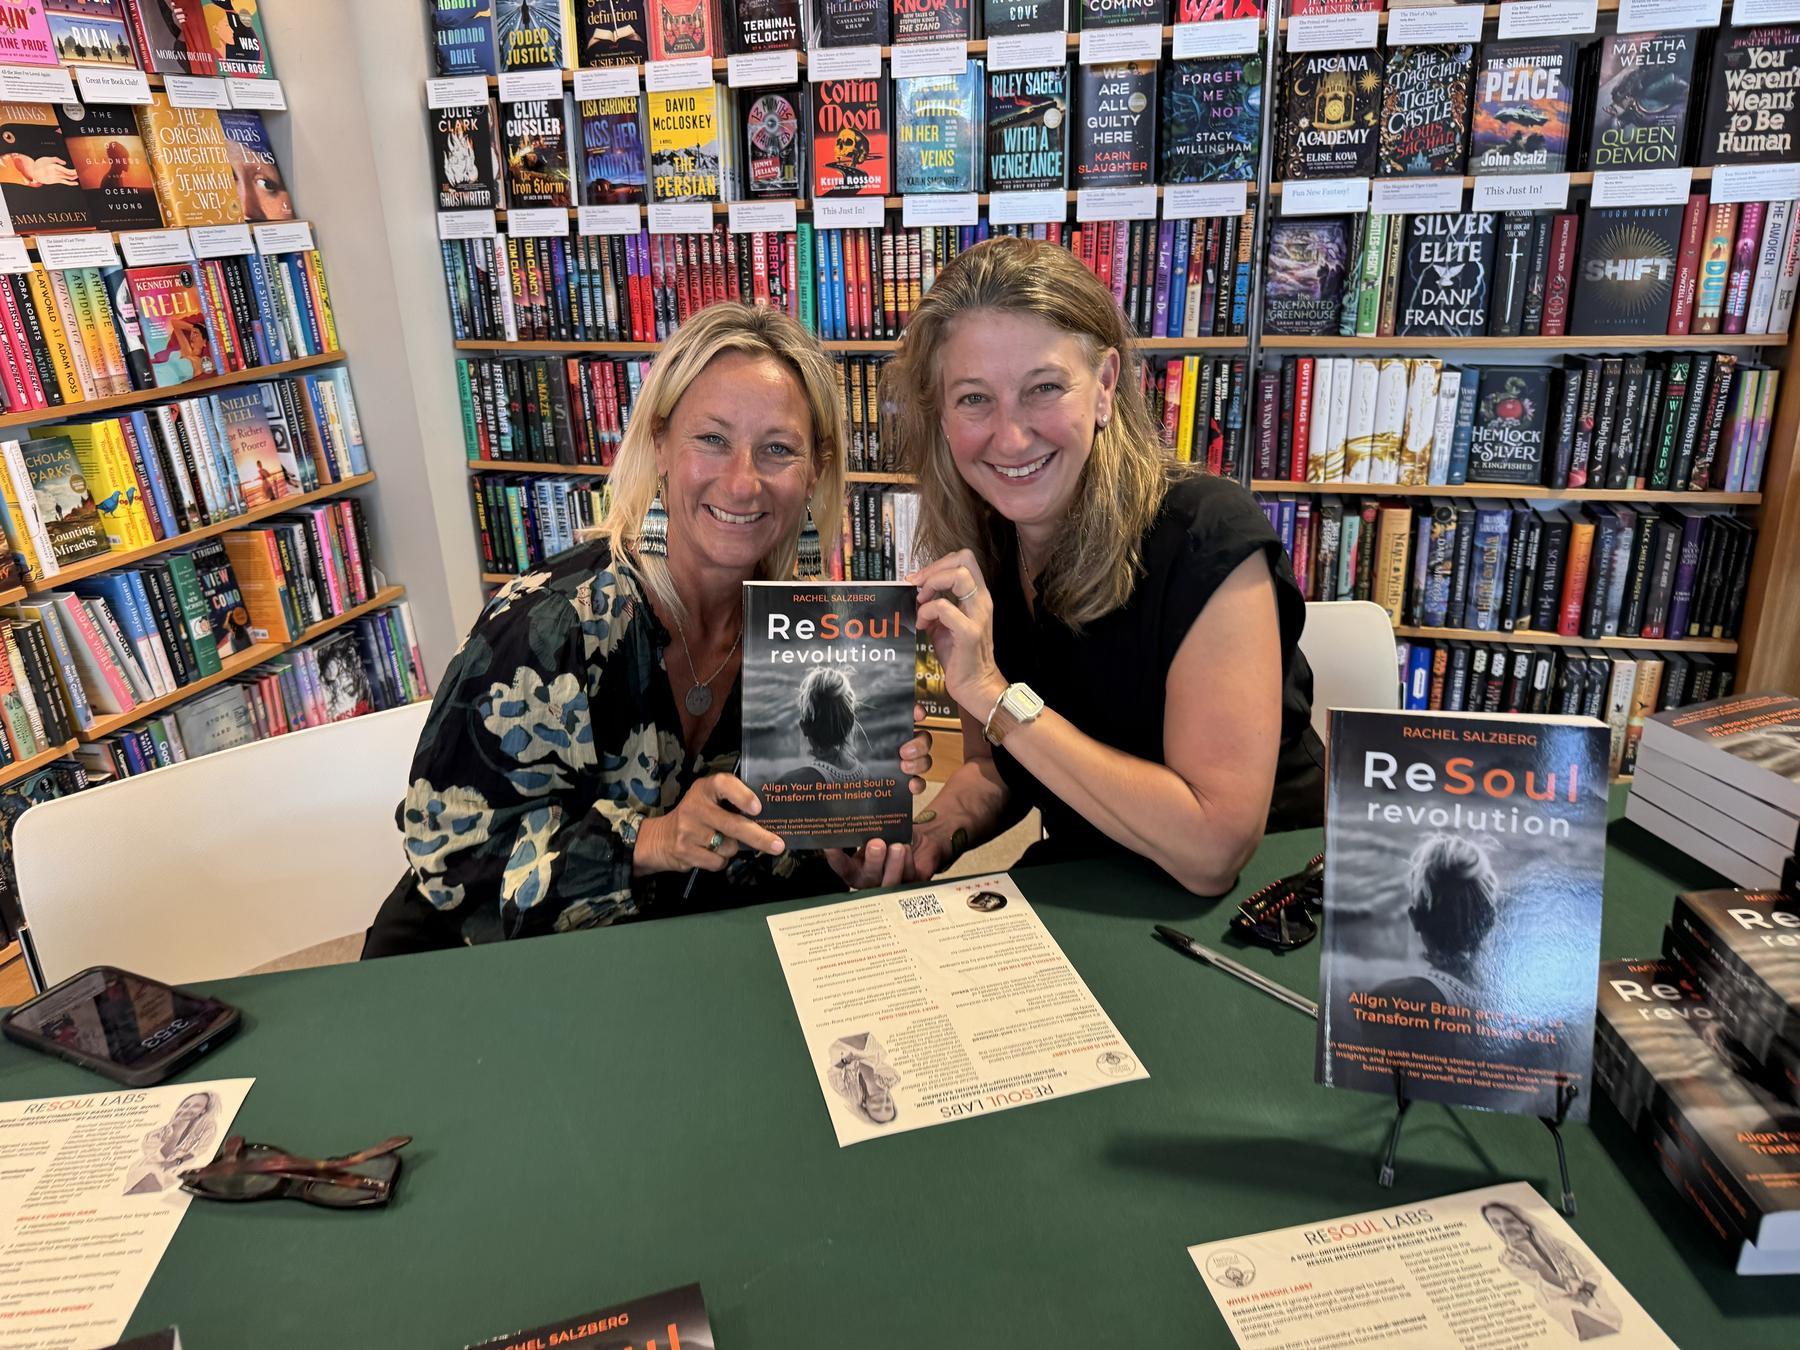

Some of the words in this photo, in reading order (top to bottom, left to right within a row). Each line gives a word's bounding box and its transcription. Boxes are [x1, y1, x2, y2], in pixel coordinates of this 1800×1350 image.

[1010, 5, 1038, 20] COVE
[743, 17, 795, 31] TERMINAL
[915, 23, 940, 32] STAND
[71, 27, 111, 48] RYAN
[239, 37, 259, 50] WAS
[744, 29, 796, 44] VELOCITY
[507, 47, 555, 65] JUSTICE
[1614, 39, 1686, 55] MARTHA
[450, 49, 476, 64] DRIVE
[1306, 56, 1368, 74] ARCANA
[1414, 52, 1436, 69] THE
[1488, 58, 1504, 69] THE
[1507, 55, 1563, 68] SHATTERING
[1621, 53, 1676, 66] WELLS
[1748, 48, 1793, 68] You
[220, 62, 246, 73] JENEVA
[249, 64, 266, 74] ROSE
[992, 73, 1021, 98] RILEY
[1026, 72, 1062, 95] SAGER
[1183, 71, 1243, 85] FORGET
[1485, 68, 1560, 102] PEACE
[1725, 66, 1800, 90] Weren't
[820, 78, 878, 105] Coffin
[1099, 83, 1129, 95] ARE
[1204, 90, 1224, 101] ME
[514, 101, 549, 118] CLIVE
[666, 99, 695, 112] DAVID
[1099, 100, 1128, 112] ALL
[1400, 90, 1444, 111] TIGER
[1727, 90, 1795, 112] Meant
[2, 106, 46, 120] THINGS
[819, 105, 881, 132] Moon
[1088, 115, 1140, 128] GUILTY
[1211, 107, 1243, 118] NOT
[1726, 113, 1752, 131] to
[1755, 110, 1785, 130] Be
[438, 119, 478, 132] CLARK
[506, 118, 561, 137] CUSSLER
[654, 115, 711, 131] McCLOSKEY
[160, 127, 224, 144] ORIGINAL
[1003, 127, 1036, 151] WITH
[1040, 127, 1048, 150] A
[1094, 131, 1132, 144] HERE
[1196, 132, 1231, 142] STACY
[1297, 129, 1370, 150] ACADEMY
[1602, 126, 1675, 146] QUEEN
[1717, 133, 1791, 154] Human
[163, 147, 229, 165] DAUGHTER
[1095, 152, 1130, 160] KARIN
[1176, 144, 1252, 155] WILLINGHAM
[1307, 153, 1332, 162] ELISE
[1336, 152, 1357, 160] KOVA
[1481, 153, 1509, 166] John
[1513, 151, 1546, 164] Scalzi
[1596, 145, 1677, 164] DEMON
[674, 157, 695, 172] THE
[921, 150, 954, 170] VEINS
[991, 151, 1062, 179] VENGEANCE
[1078, 162, 1147, 173] SLAUGHTER
[755, 167, 779, 176] JULIANO
[657, 176, 716, 197] PERSIAN
[821, 176, 844, 186] KEITH
[847, 176, 881, 185] ROSSON
[440, 191, 490, 207] GHOSTWRITER
[1306, 188, 1320, 196] New
[1322, 187, 1350, 196] Fantasy!
[1485, 187, 1504, 195] This
[1530, 186, 1542, 194] In!
[855, 206, 865, 214] In!
[1635, 209, 1669, 217] HOWEY
[1414, 215, 1492, 235] SILVER
[1420, 242, 1482, 262] ELITE
[1585, 257, 1675, 282] SHIFT
[136, 281, 173, 291] KENNEDY
[254, 263, 264, 285] LOST
[260, 290, 272, 319] STORY
[1698, 260, 1727, 318] DUNE
[36, 269, 57, 322] PLAYWORLD
[72, 275, 95, 330] ANTIDOTE
[90, 273, 112, 327] ANTIDOTE
[1422, 289, 1470, 305] DANI
[16, 274, 27, 299] NORA
[25, 302, 41, 341] ROBERTS
[141, 293, 199, 318] REEL
[1270, 309, 1335, 319] GREENHOUSE
[1273, 300, 1333, 310] ENCHANTED
[1405, 310, 1484, 325] FRANCIS
[34, 348, 50, 383] NATURE
[57, 343, 70, 369] ADAM
[67, 370, 78, 394] ROSS
[1301, 363, 1310, 397] GUTTER
[473, 394, 482, 423] QUEEN
[1299, 400, 1308, 423] MAGE
[1472, 426, 1541, 444] HEMLOCK
[1659, 401, 1680, 470] WICKED
[203, 569, 229, 588] VIEW
[212, 589, 241, 609] COMO
[793, 594, 828, 603] RACHEL
[831, 594, 876, 603] SALZBERG
[767, 612, 900, 640] ReSoul
[771, 643, 896, 664] revolution
[1402, 727, 1459, 742] RACHEL
[1463, 730, 1537, 747] SALZBERG
[1363, 750, 1579, 803] ReSoul
[762, 782, 787, 793] Align
[791, 782, 813, 791] Your
[816, 781, 841, 791] Brain
[843, 781, 861, 790] and
[863, 779, 884, 788] Soul
[886, 779, 895, 787] to
[766, 793, 816, 802] Transform
[818, 793, 842, 801] from
[844, 790, 872, 800] Inside
[874, 789, 892, 798] Out
[1367, 800, 1570, 838] revolution
[1349, 991, 1387, 1008] Align
[1392, 997, 1427, 1013] Your
[1431, 1001, 1471, 1018] Brain
[1353, 1008, 1430, 1029] Transform
[1434, 1017, 1471, 1034] from
[1476, 1024, 1522, 1041] Inside
[1527, 1030, 1557, 1045] Out
[24, 1098, 95, 1114] RESOUL
[100, 1093, 148, 1106] LABS
[986, 1084, 1054, 1107] RESOUL
[940, 1099, 984, 1118] LABS
[1304, 1218, 1383, 1246] RESOUL
[1383, 1209, 1435, 1230] LABS
[1227, 1296, 1249, 1307] WHAT
[550, 1313, 629, 1345] SALZBERG
